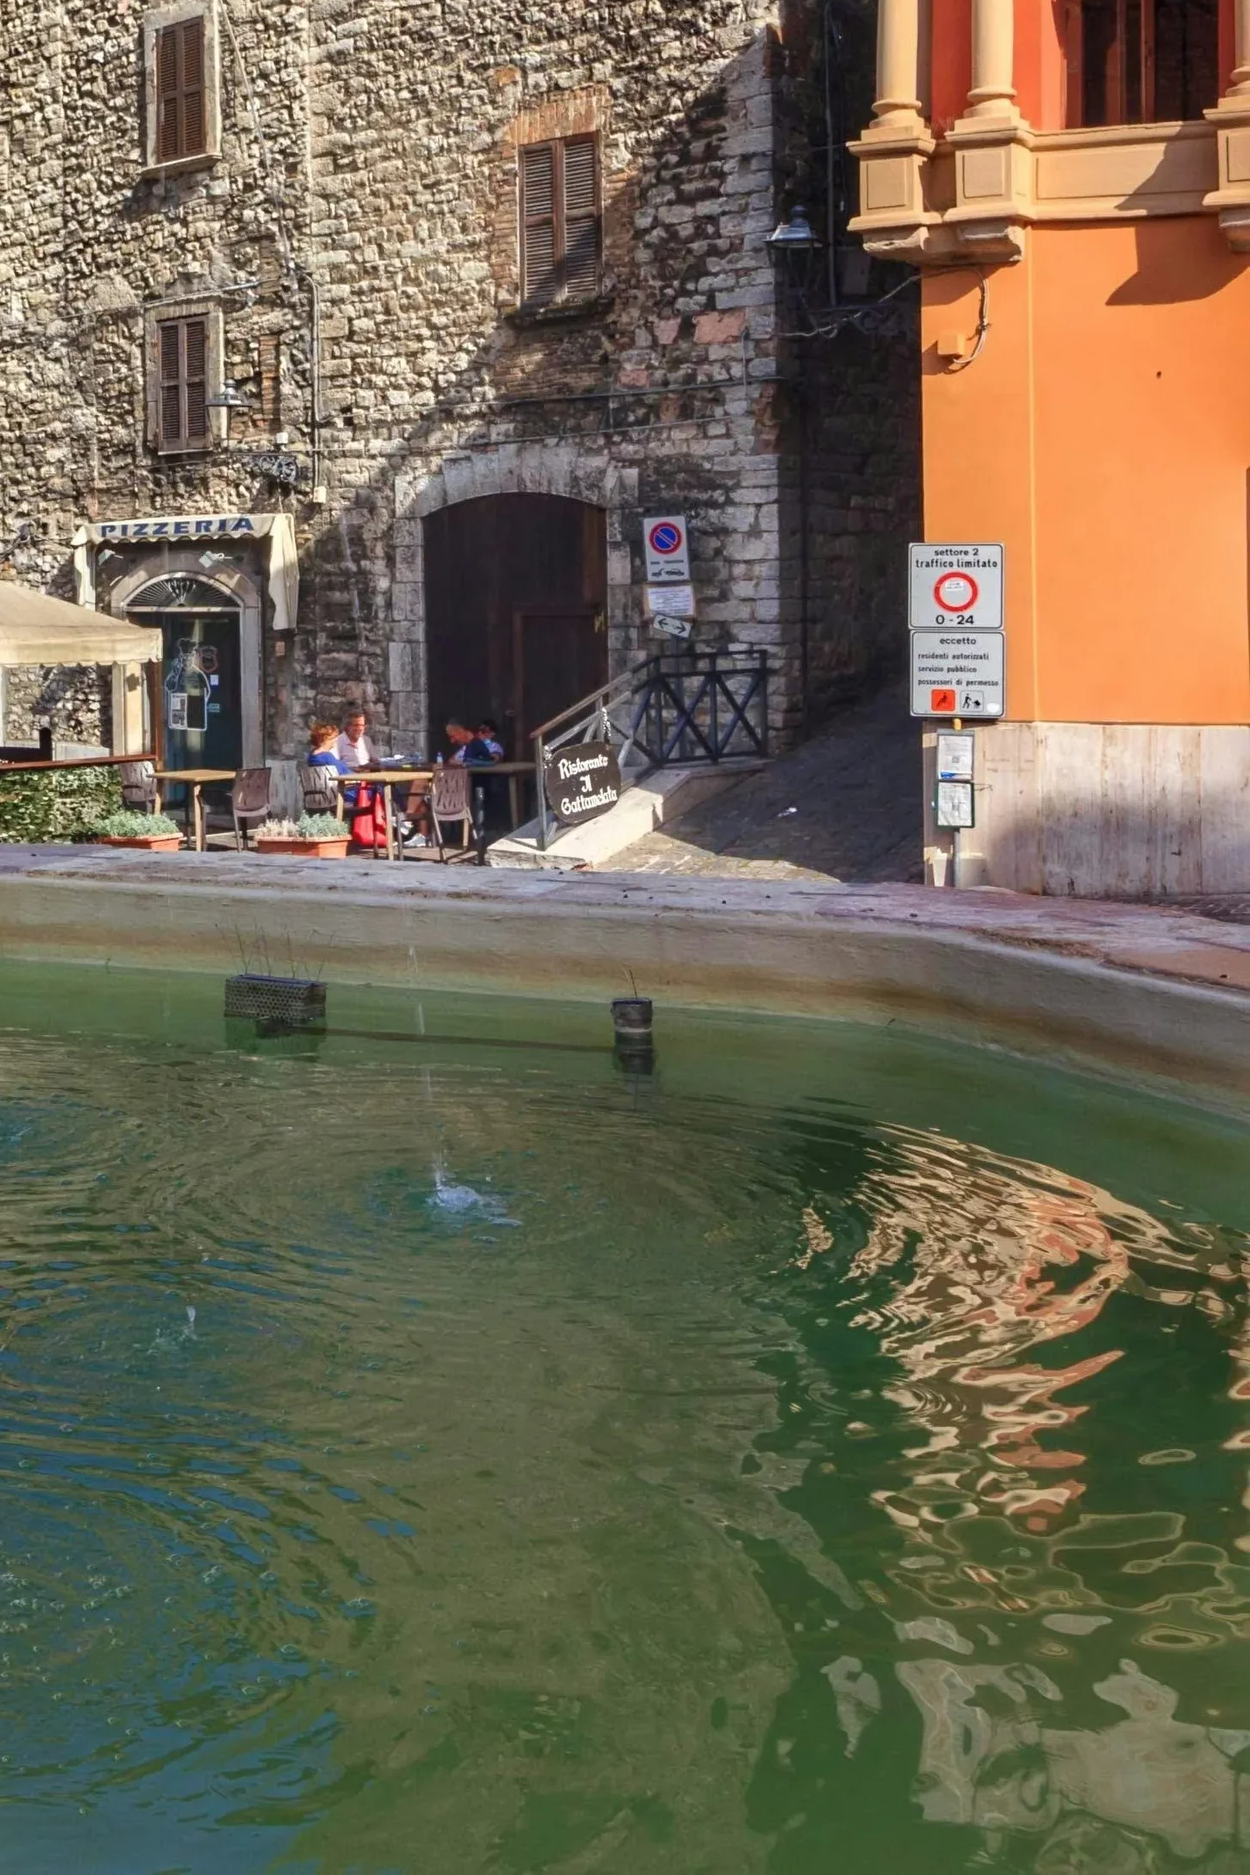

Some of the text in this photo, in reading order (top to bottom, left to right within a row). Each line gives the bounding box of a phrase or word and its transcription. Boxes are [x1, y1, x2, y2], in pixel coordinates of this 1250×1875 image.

[101, 517, 255, 538] PIZZERIA
[934, 547, 979, 556] settore 2
[915, 558, 998, 568] traffico limitato
[956, 614, 974, 625] 24
[939, 637, 977, 645] eccetto
[918, 652, 989, 660] residenti autorizzati
[918, 665, 977, 674] servizio pubblico
[918, 678, 999, 687] possessori di permesso
[558, 754, 609, 780] Ristorante
